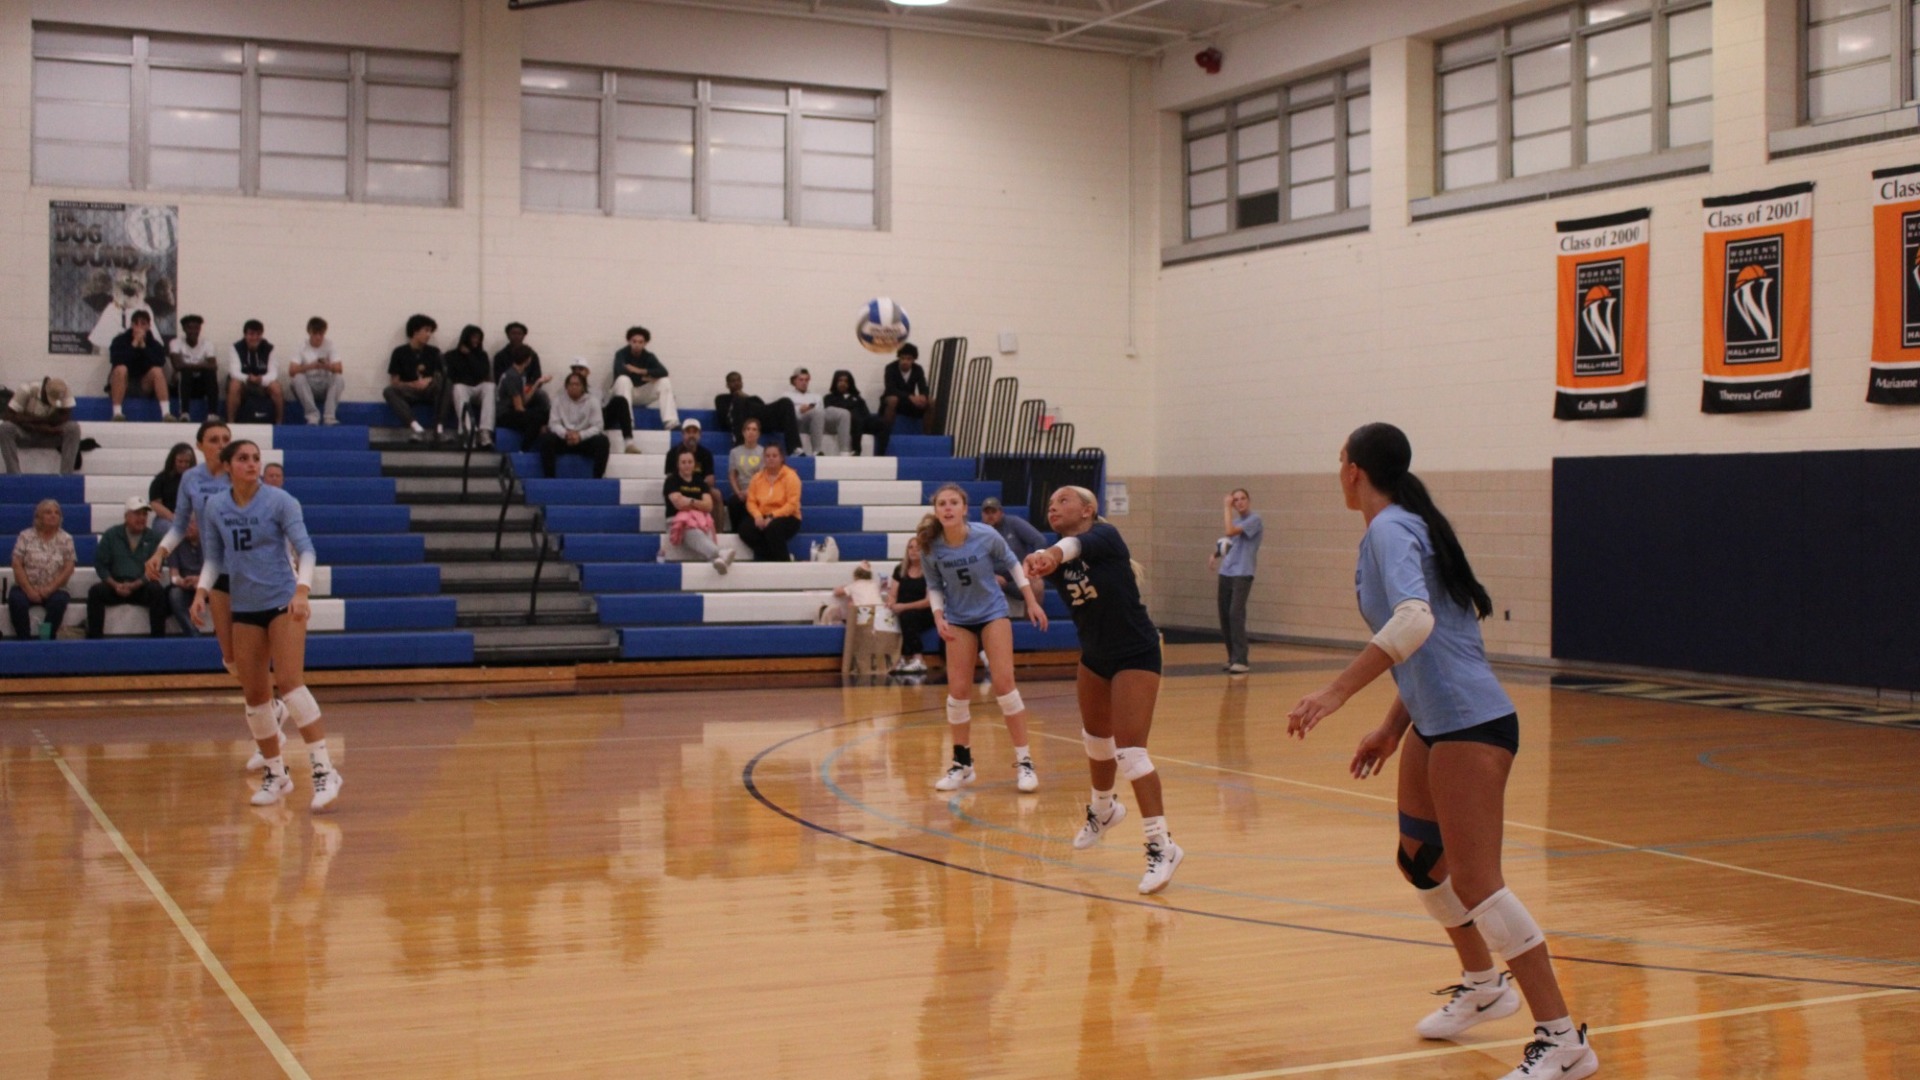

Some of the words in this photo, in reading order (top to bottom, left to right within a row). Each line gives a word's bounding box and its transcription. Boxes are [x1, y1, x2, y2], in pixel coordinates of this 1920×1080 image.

[1881, 181, 1920, 200] Class
[1708, 210, 1743, 228] Class
[1747, 205, 1761, 224] of
[1766, 200, 1800, 220] 2001
[56, 224, 103, 244] DOG
[1560, 235, 1591, 253] Class
[1594, 231, 1607, 249] of
[1611, 226, 1640, 246] 2000
[1730, 245, 1777, 257] WOMEN'S
[1580, 267, 1620, 279] WOMEN'S
[1728, 349, 1748, 357] HALL
[1756, 346, 1776, 355] FAME
[1577, 363, 1595, 371] HALL
[1602, 361, 1619, 370] FAME
[1718, 389, 1752, 402] Theresa
[1753, 388, 1783, 401] Grentz
[1577, 399, 1598, 414] Cathy
[231, 528, 253, 552] 12
[956, 567, 972, 586] 5
[1066, 575, 1098, 606] 25
